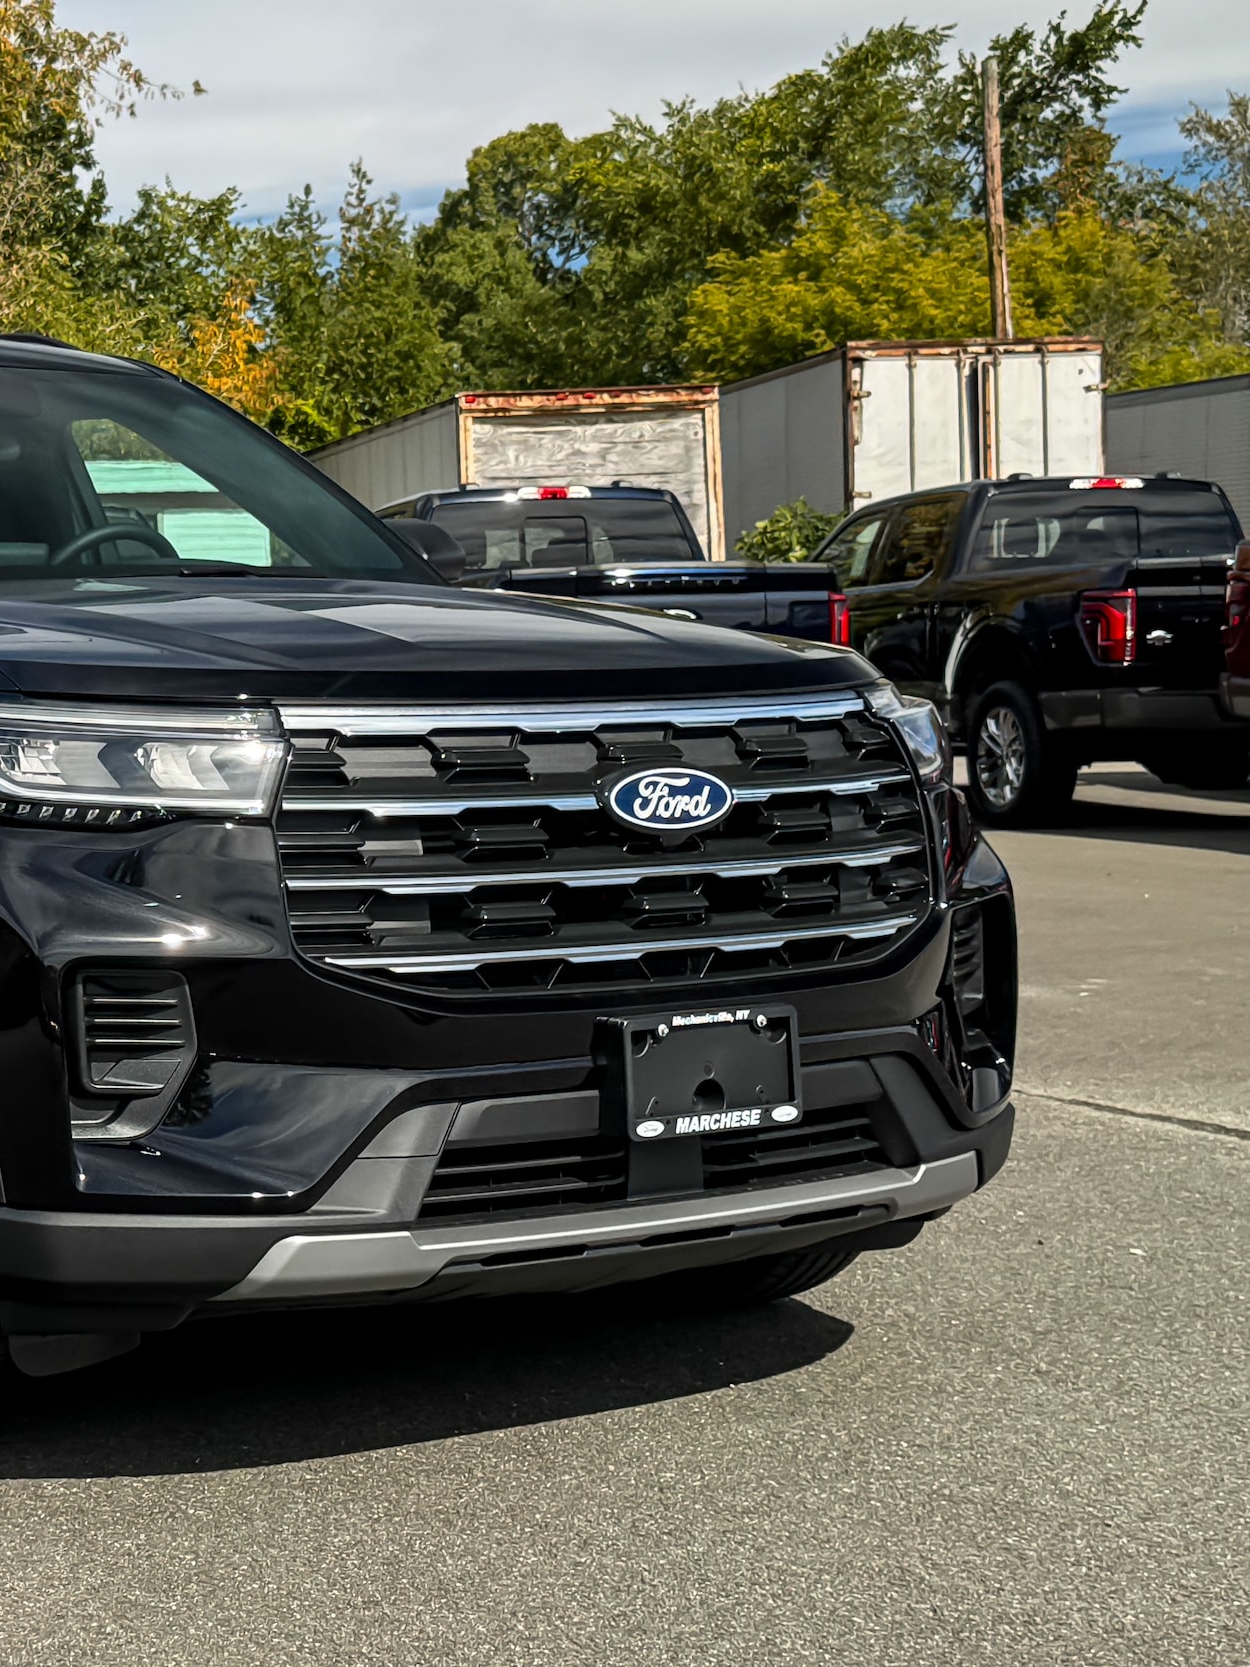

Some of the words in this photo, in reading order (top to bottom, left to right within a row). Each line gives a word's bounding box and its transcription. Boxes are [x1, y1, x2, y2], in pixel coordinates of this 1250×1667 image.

[633, 776, 712, 820] Ford
[735, 1009, 751, 1021] NY
[675, 1109, 762, 1134] MARCHESE
